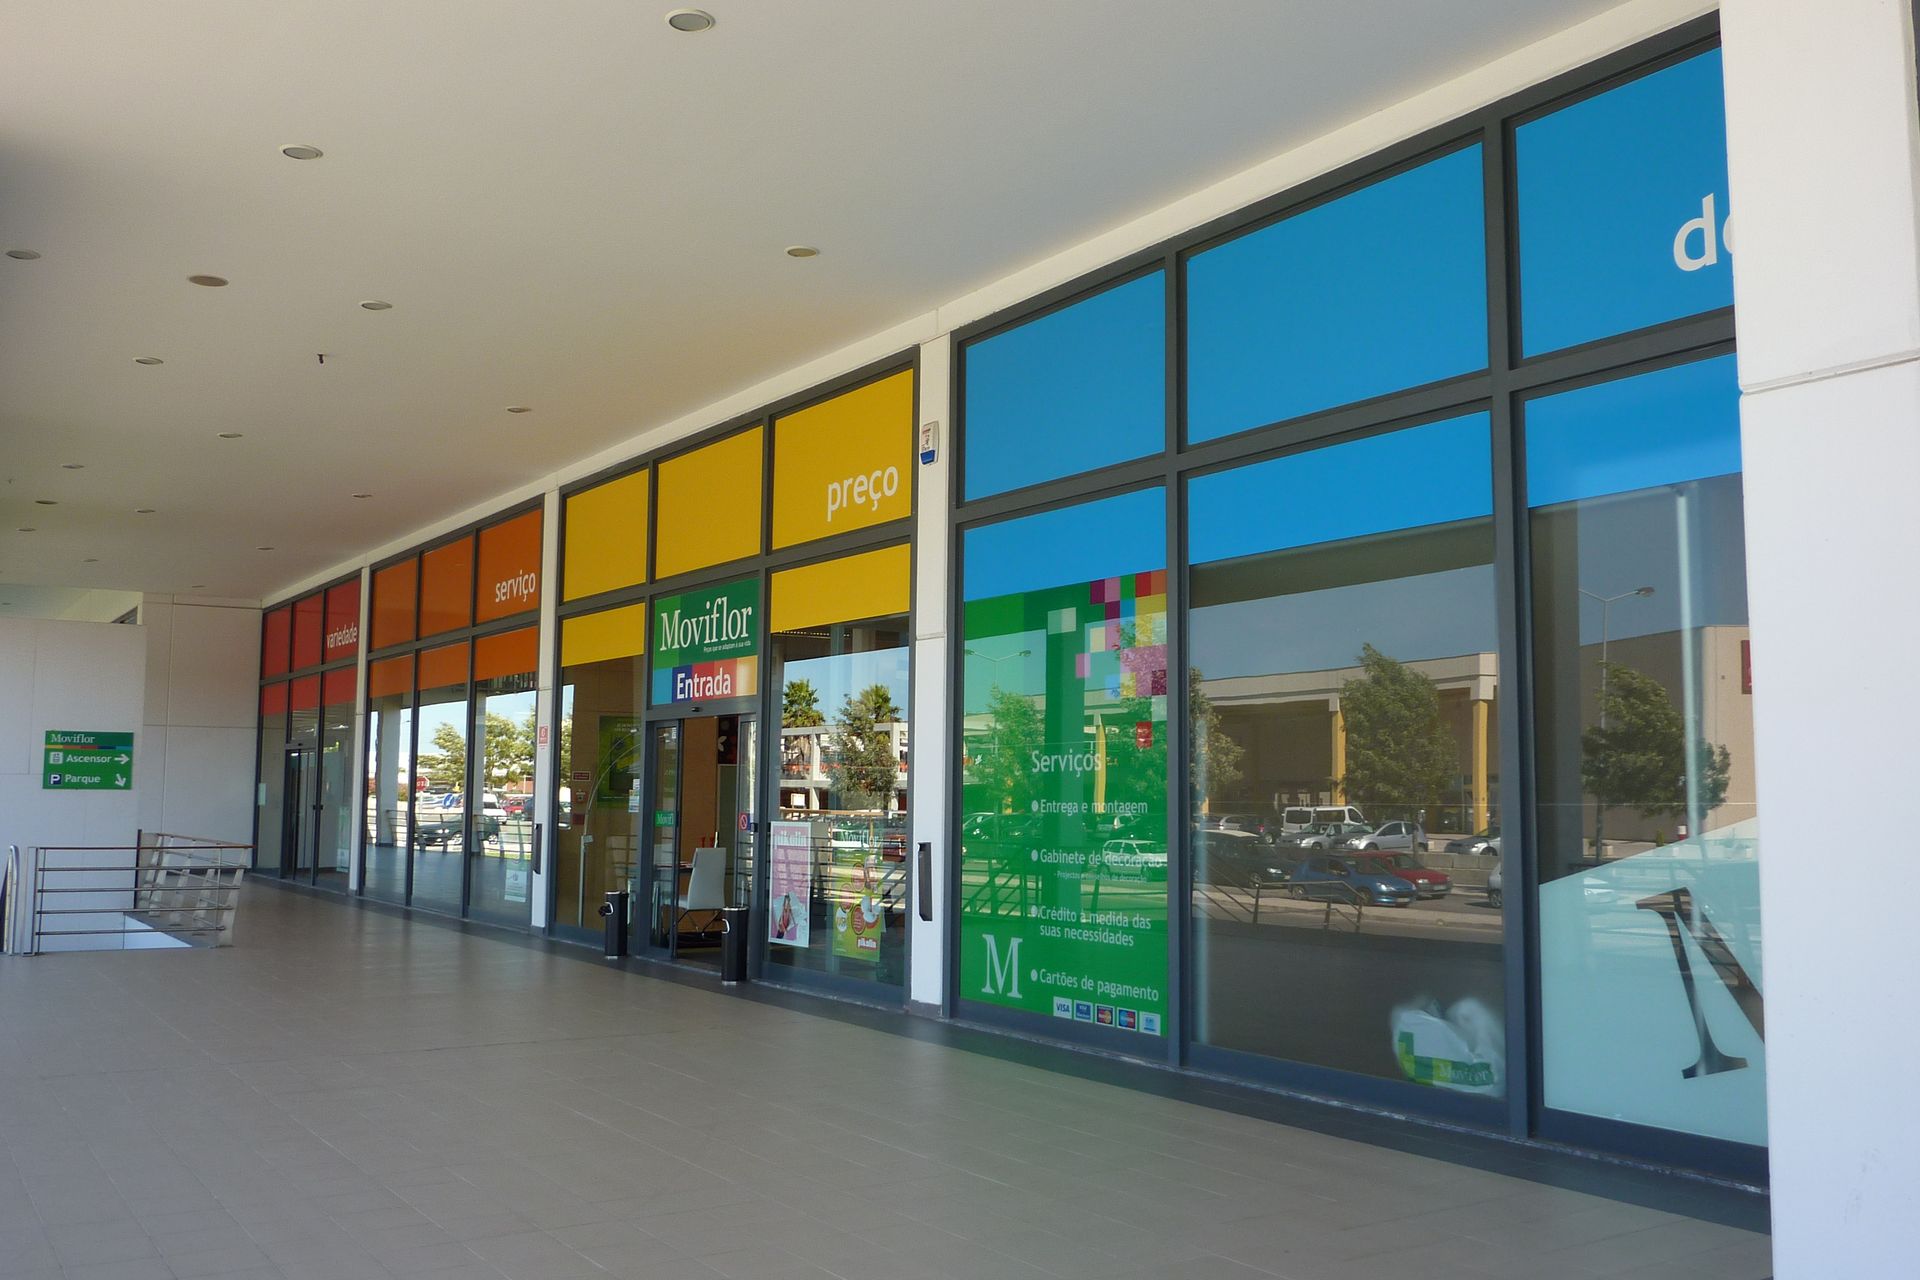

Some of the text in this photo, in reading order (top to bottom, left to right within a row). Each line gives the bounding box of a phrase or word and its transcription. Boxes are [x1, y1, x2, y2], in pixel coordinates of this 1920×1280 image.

[1673, 193, 1732, 271] d
[827, 466, 899, 522] preço
[496, 569, 536, 603] serviço
[326, 621, 358, 649] variedade
[660, 596, 752, 651] Moviflor
[676, 667, 732, 699] Entrada
[51, 733, 95, 743] Moviflor
[66, 754, 112, 763] Ascensor
[1031, 749, 1102, 777] Serviços
[65, 774, 101, 784] Parque
[1040, 799, 1148, 816] Entrega e montagem
[1040, 849, 1086, 865] Gabinete
[1089, 850, 1101, 865] de
[1040, 905, 1077, 923] Crédito
[1089, 911, 1129, 928] medida
[1132, 915, 1152, 929] das
[1040, 924, 1134, 947] suas necessidades
[981, 934, 1024, 998] M
[1040, 968, 1159, 1001] Cartões de pagamento
[1055, 1002, 1070, 1013] VISA
